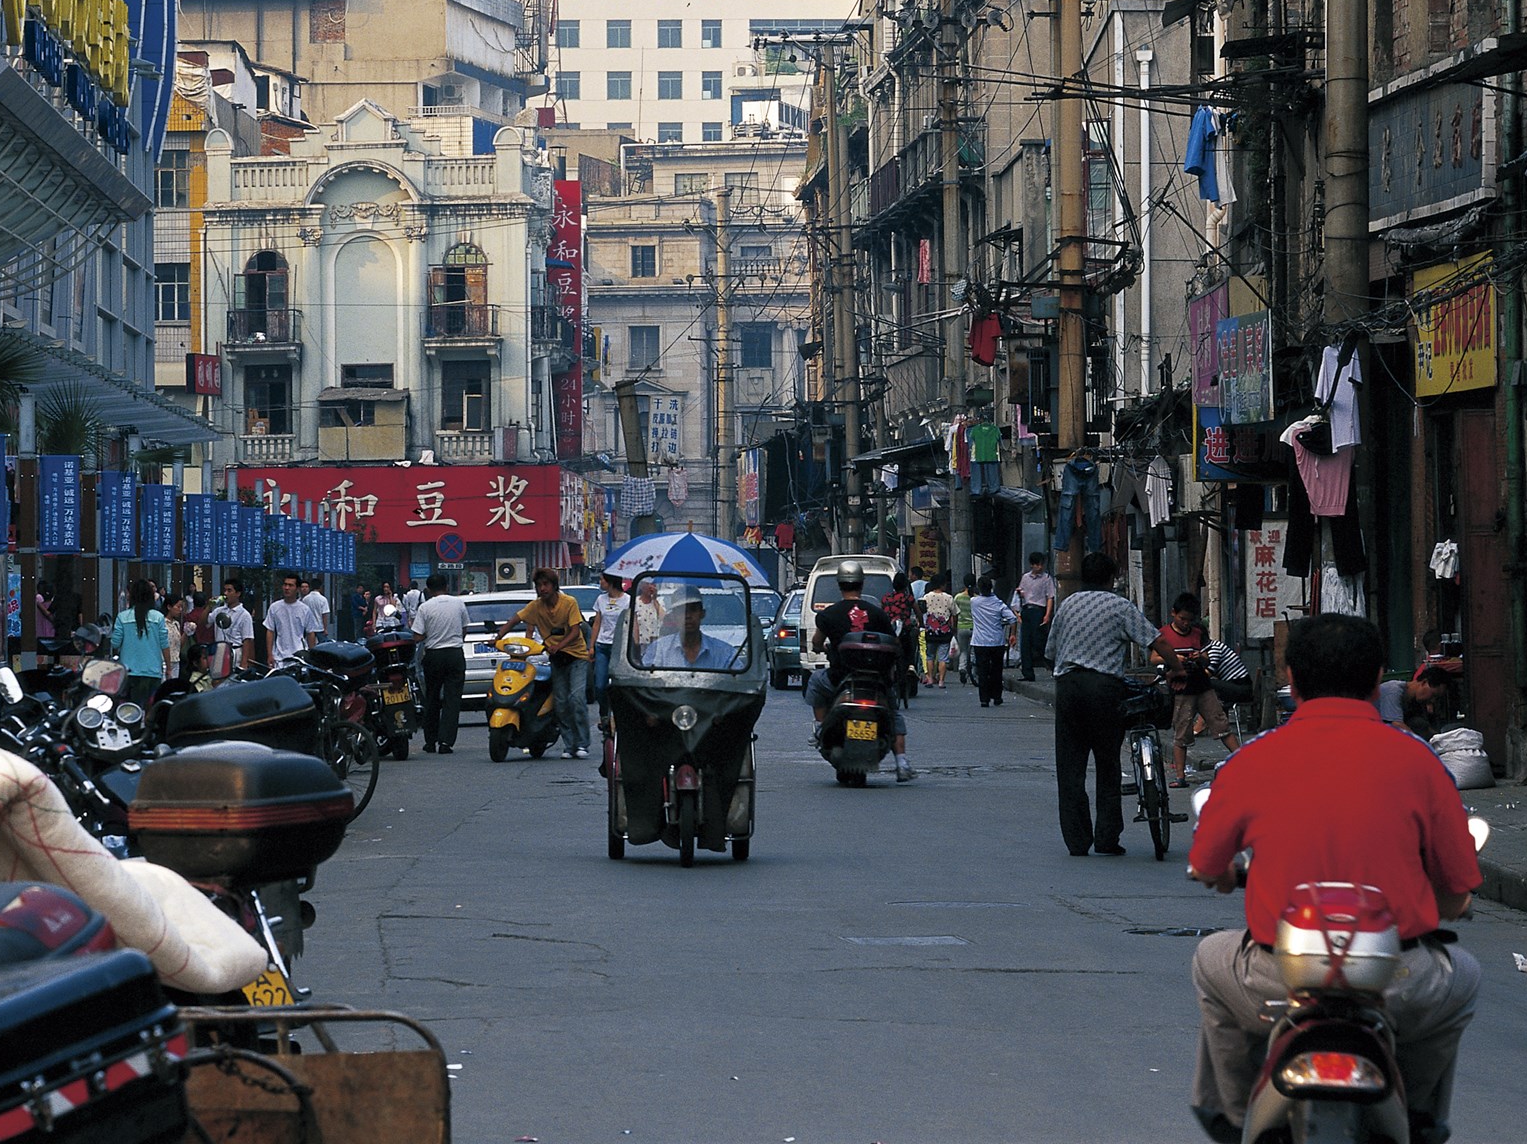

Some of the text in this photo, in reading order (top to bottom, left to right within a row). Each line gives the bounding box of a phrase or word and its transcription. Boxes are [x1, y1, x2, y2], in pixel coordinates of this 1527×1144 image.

[263, 474, 536, 531] 永和豆浆
[1255, 544, 1278, 618] 麻花店
